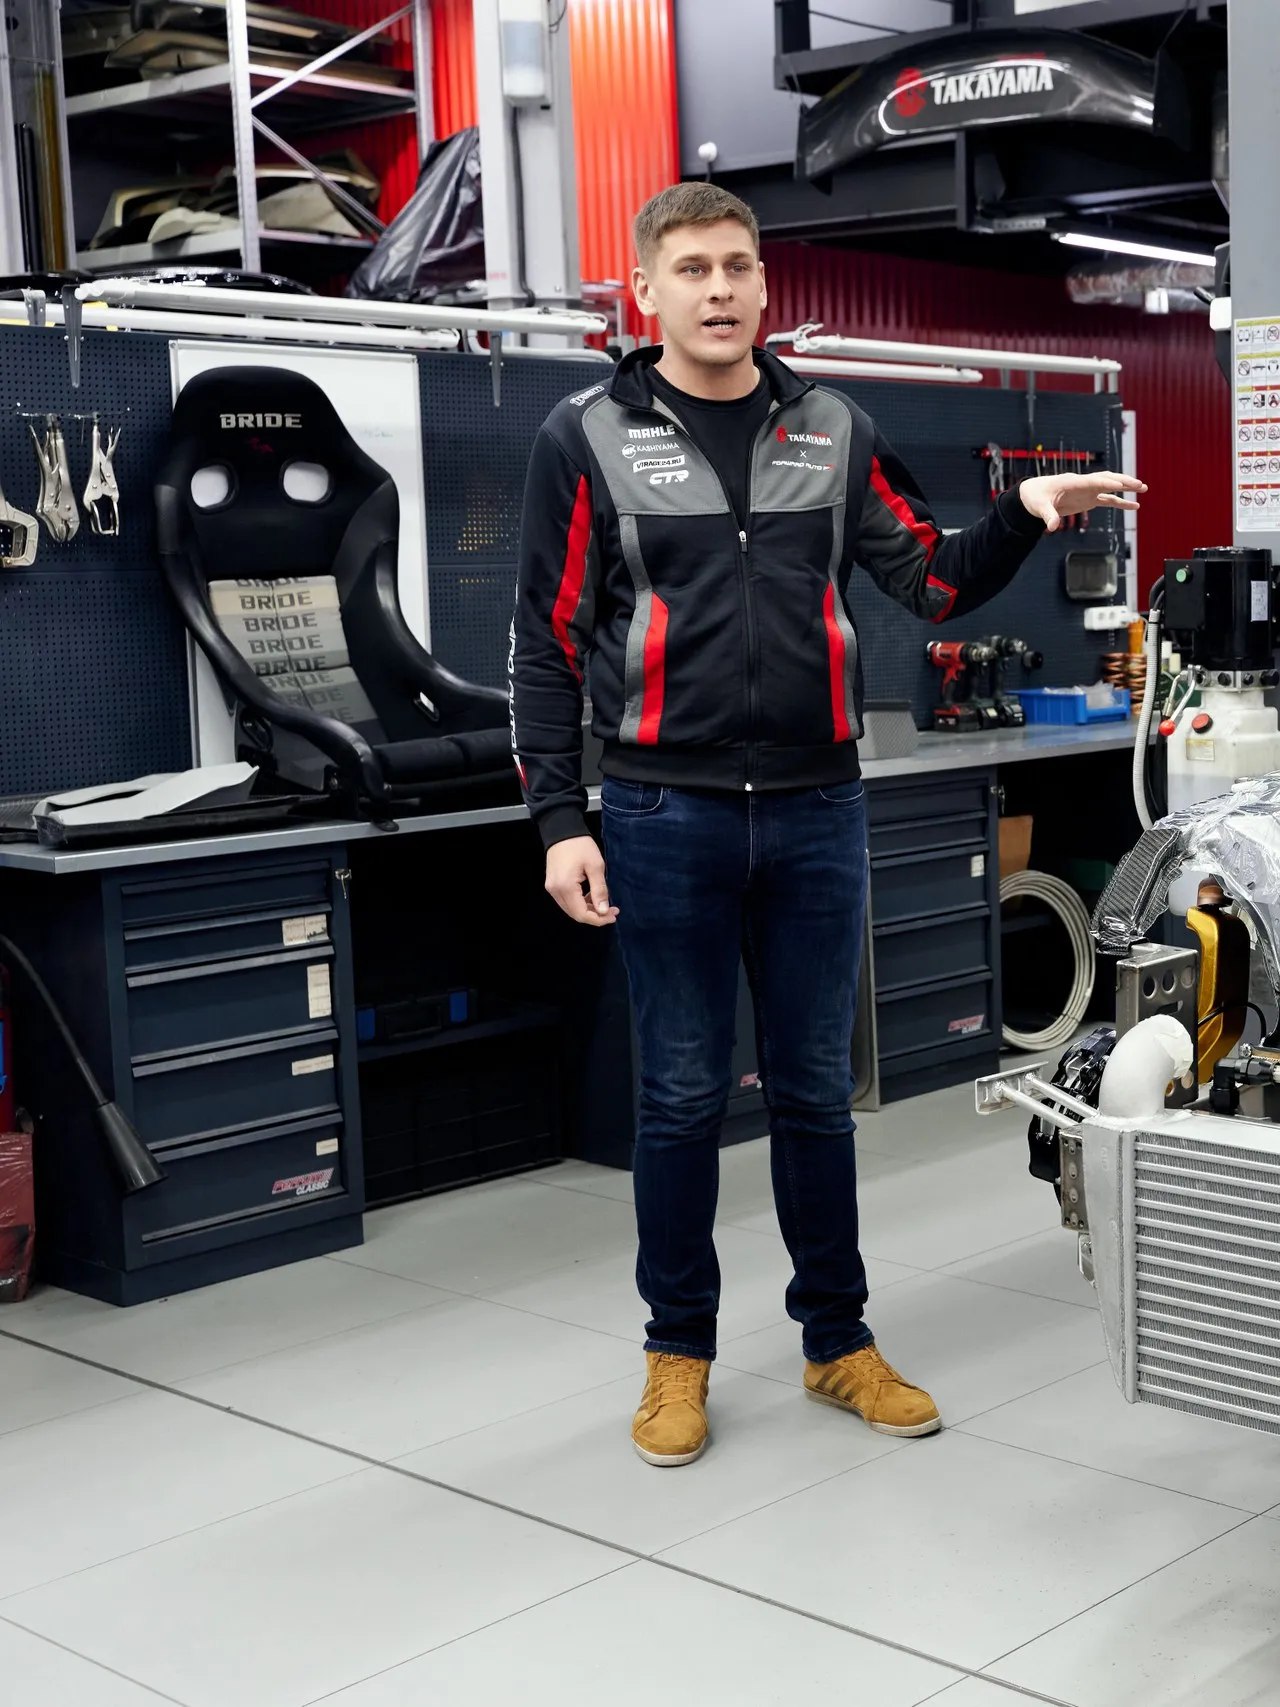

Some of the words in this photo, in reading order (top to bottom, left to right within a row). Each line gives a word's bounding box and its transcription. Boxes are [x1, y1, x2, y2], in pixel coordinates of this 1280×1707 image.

[930, 66, 1053, 105] TAKAYAMA
[220, 413, 302, 428] BRIDE
[628, 424, 675, 438] MAHLE
[637, 442, 679, 452] KASHIYAMA
[787, 433, 832, 446] TAKAYAMA
[239, 591, 313, 610] BRIDE
[242, 612, 318, 632] BRIDE
[248, 634, 324, 654] BRIDE
[296, 1180, 330, 1196] CLASSIC
